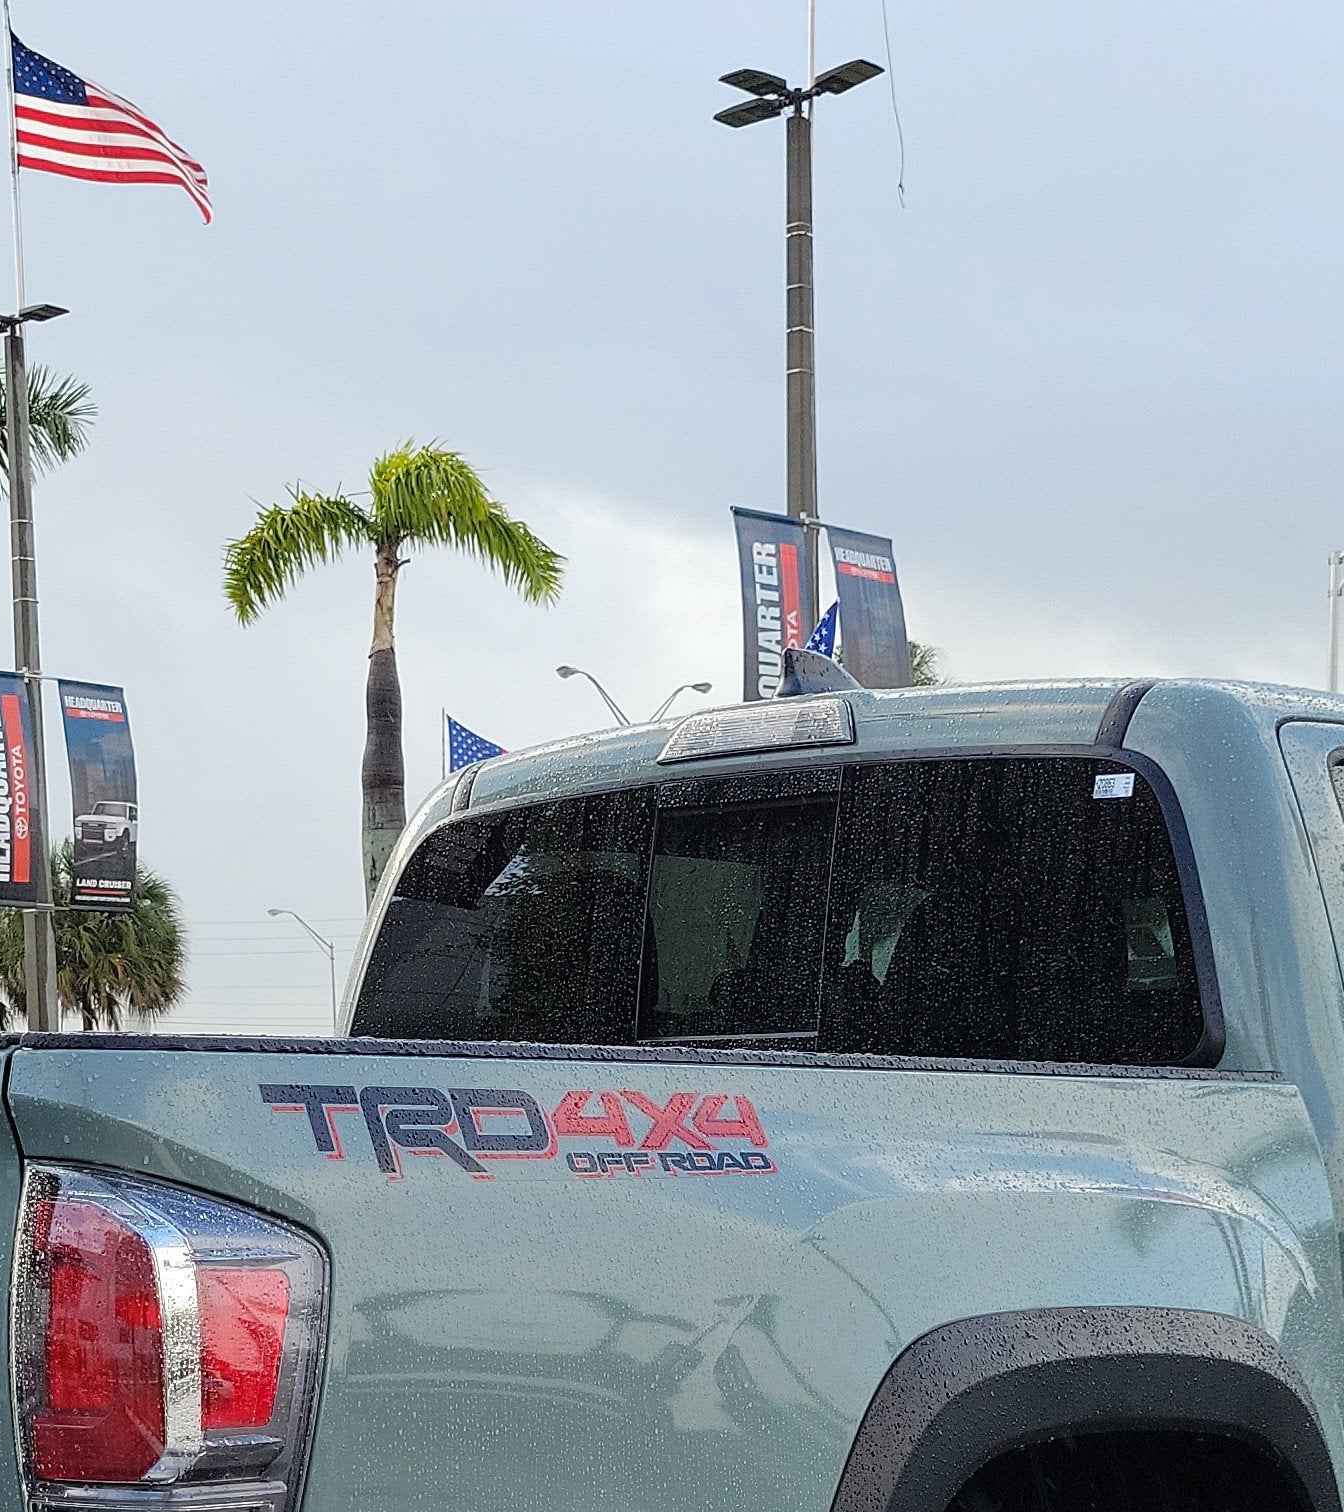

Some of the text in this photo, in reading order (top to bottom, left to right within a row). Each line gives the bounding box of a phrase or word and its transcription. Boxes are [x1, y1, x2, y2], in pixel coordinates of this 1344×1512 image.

[64, 695, 122, 713] HEADQUARTER
[11, 745, 28, 815] TOYOTA
[76, 878, 131, 889] LAND CRUISER
[259, 1083, 768, 1181] TRD 4X4
[566, 1151, 777, 1177] OFF ROAD
